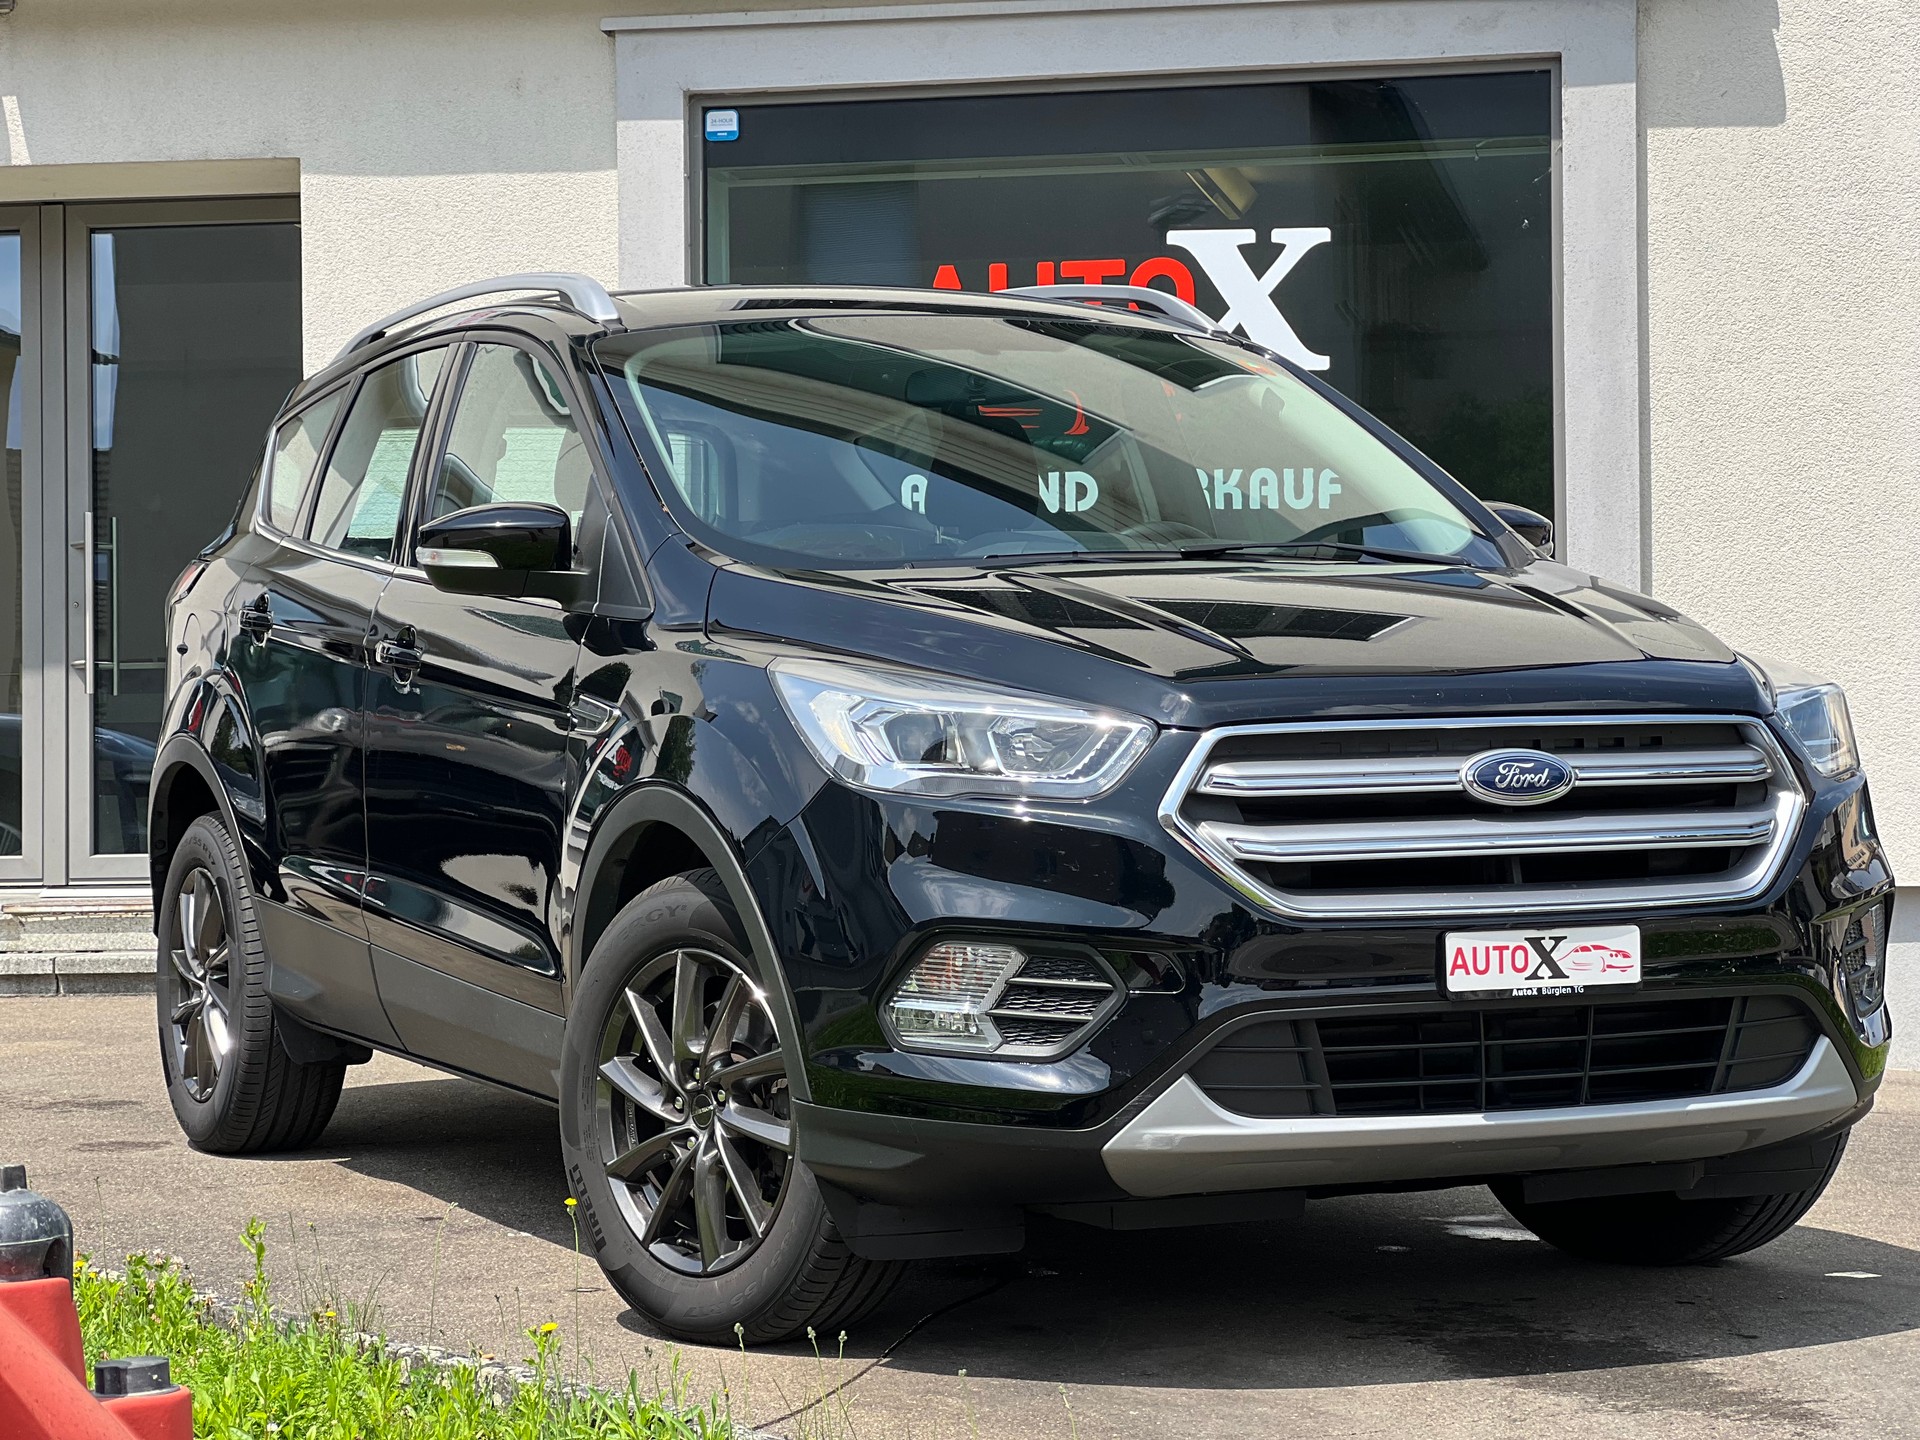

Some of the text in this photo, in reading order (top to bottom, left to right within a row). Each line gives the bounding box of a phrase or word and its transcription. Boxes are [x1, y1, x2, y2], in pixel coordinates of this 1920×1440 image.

[1494, 761, 1550, 789] Ford
[1512, 985, 1584, 996] AutoX Bürglen TG
[569, 1163, 607, 1252] PIRELLI
